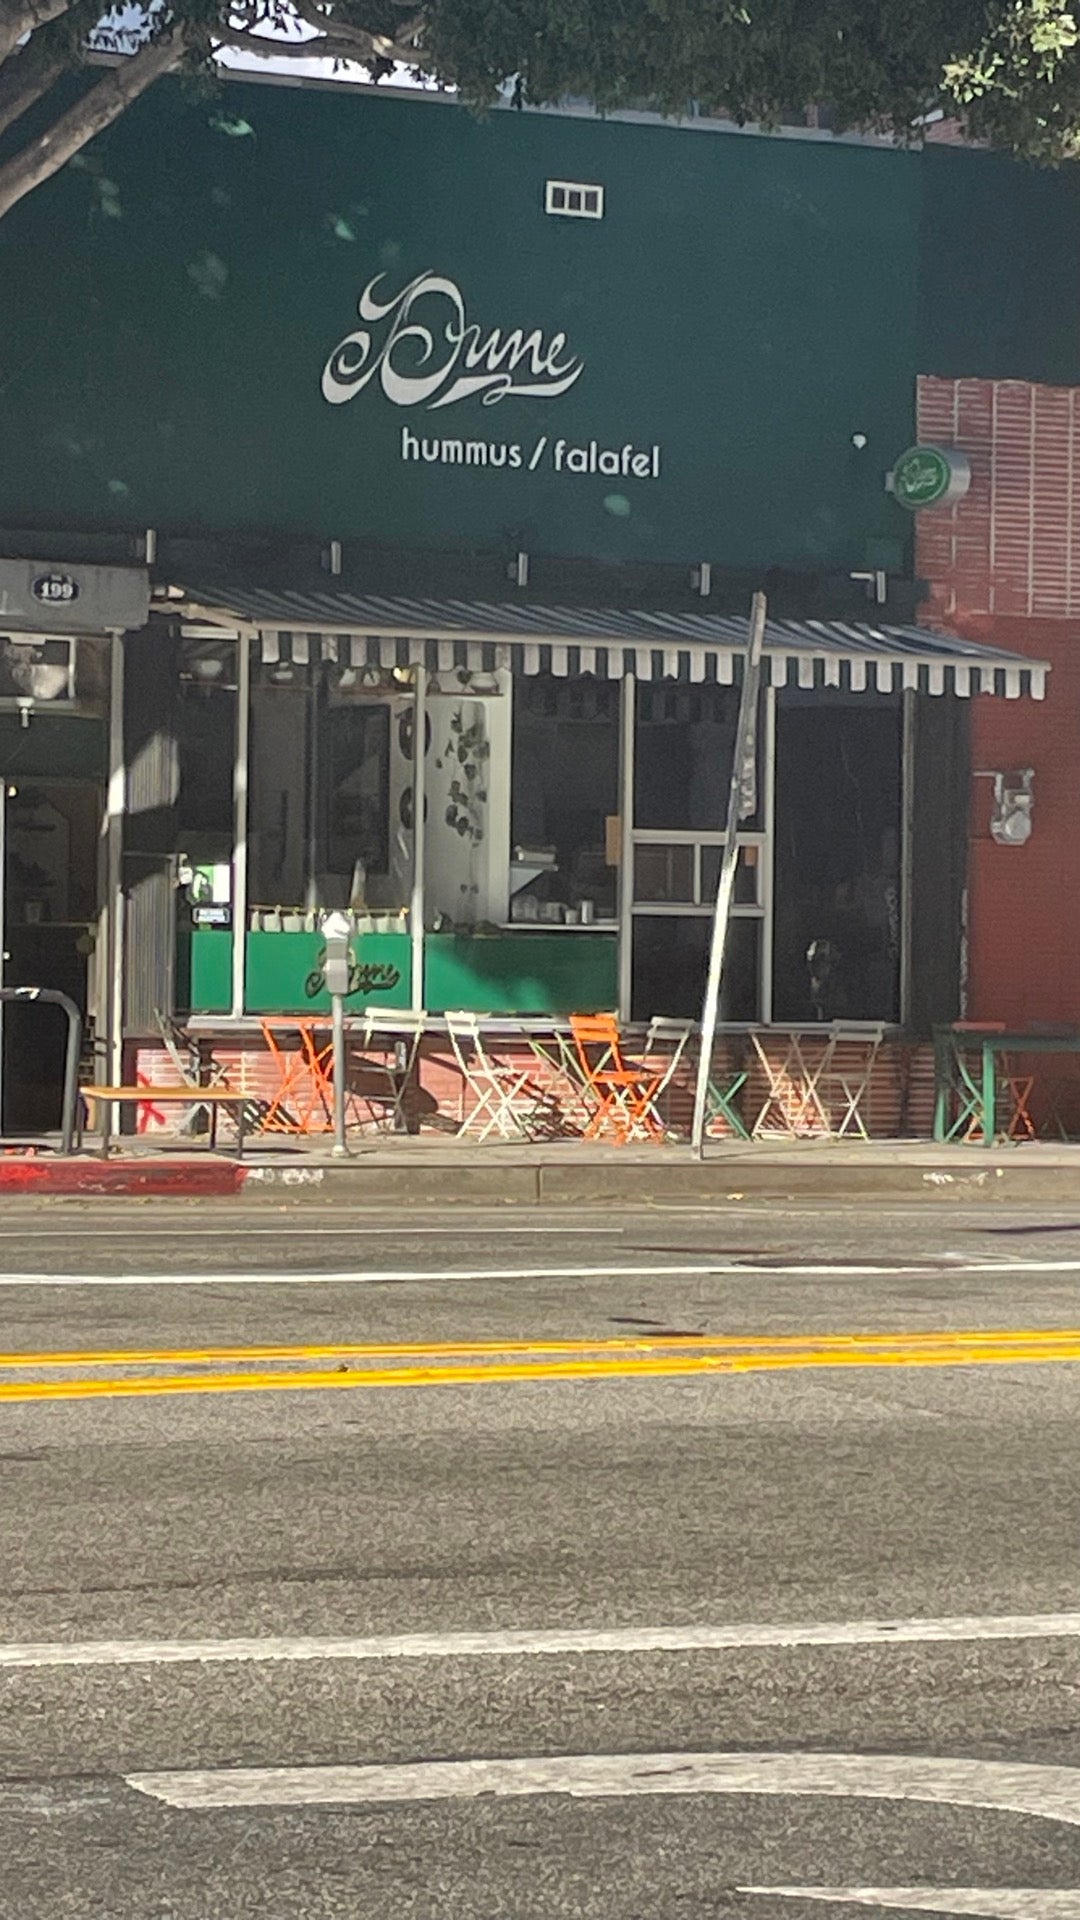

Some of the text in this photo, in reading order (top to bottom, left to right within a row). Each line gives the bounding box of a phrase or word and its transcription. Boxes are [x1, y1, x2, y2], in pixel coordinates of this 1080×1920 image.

[321, 268, 585, 410] Dune
[402, 426, 523, 468] hummus
[554, 439, 660, 478] falafel
